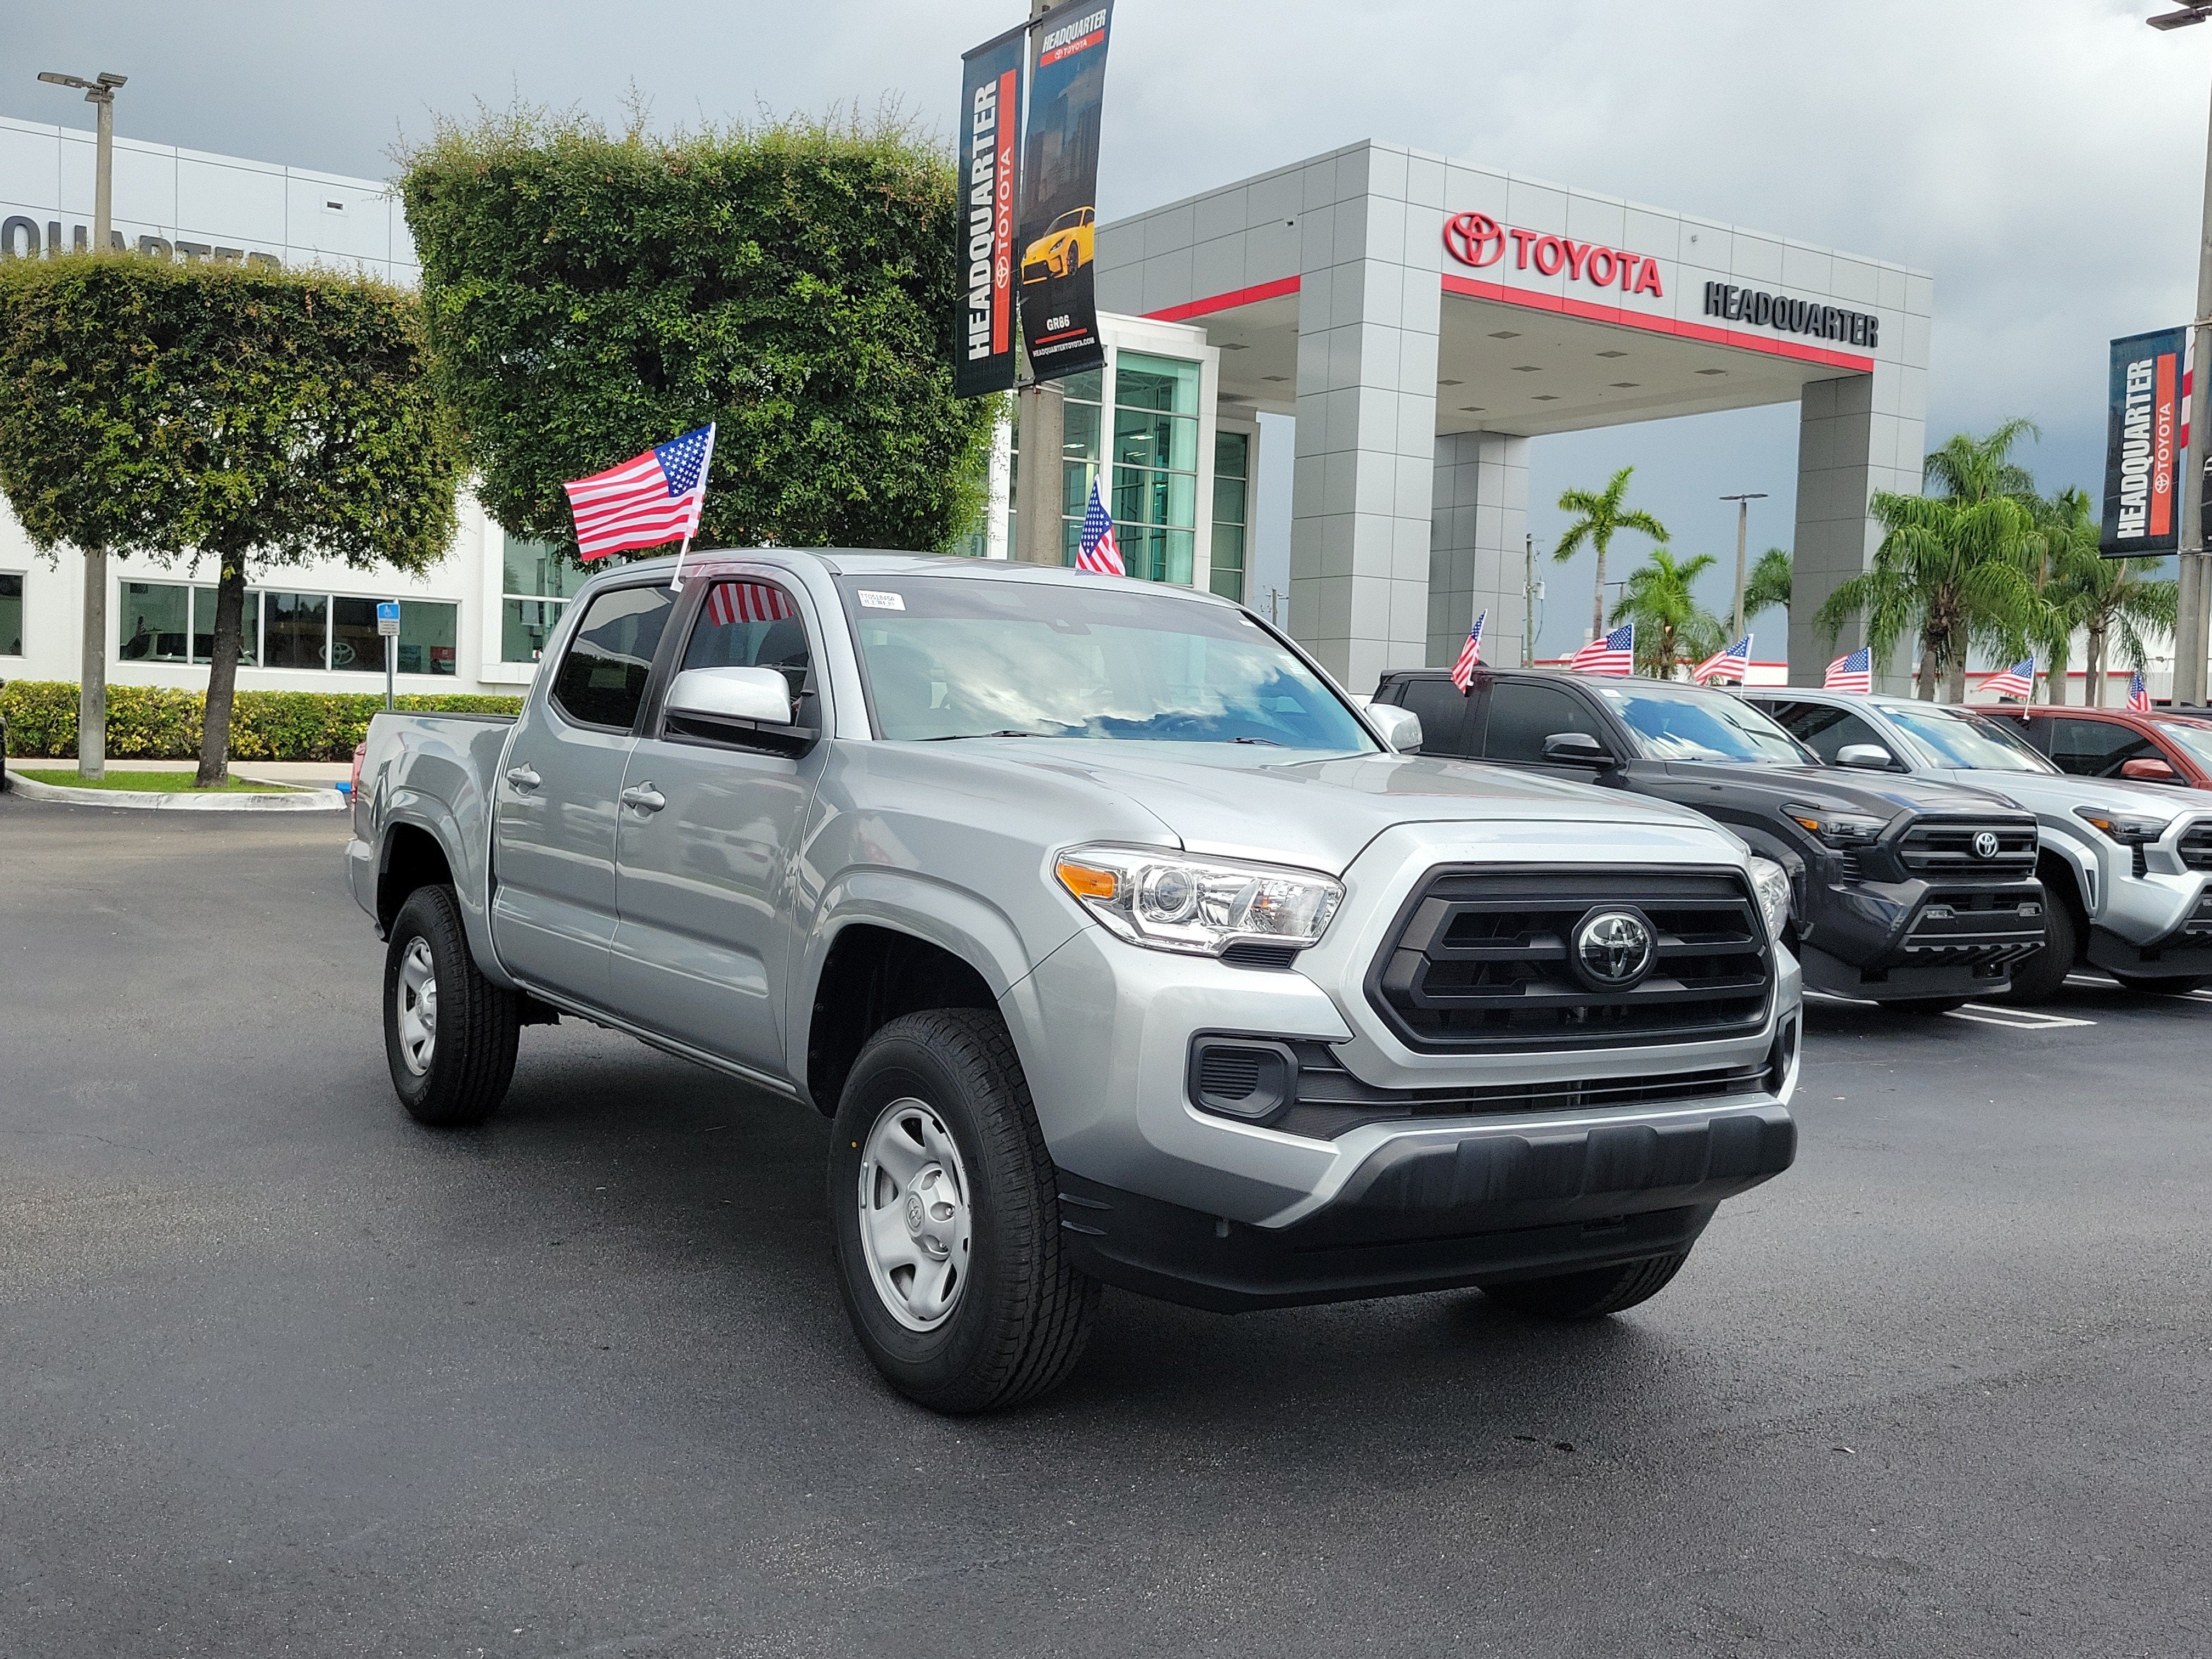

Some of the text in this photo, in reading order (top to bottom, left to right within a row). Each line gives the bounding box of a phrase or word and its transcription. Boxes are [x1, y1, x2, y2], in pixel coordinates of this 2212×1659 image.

[1043, 9, 1107, 53] HEADQUARTER
[1063, 39, 1087, 57] TOYOTA
[969, 80, 998, 360] HEADQUARTER
[998, 146, 1012, 255] TOYOTA
[1511, 229, 1663, 297] TOYOTA
[1032, 337, 1095, 357] HEADQUARTERTOYOTA.COM
[1046, 314, 1070, 331] GR86
[1705, 281, 1880, 348] HEADQUARTER
[2117, 358, 2153, 539] HEADQUARTER
[2157, 402, 2171, 471] TOYOTA
